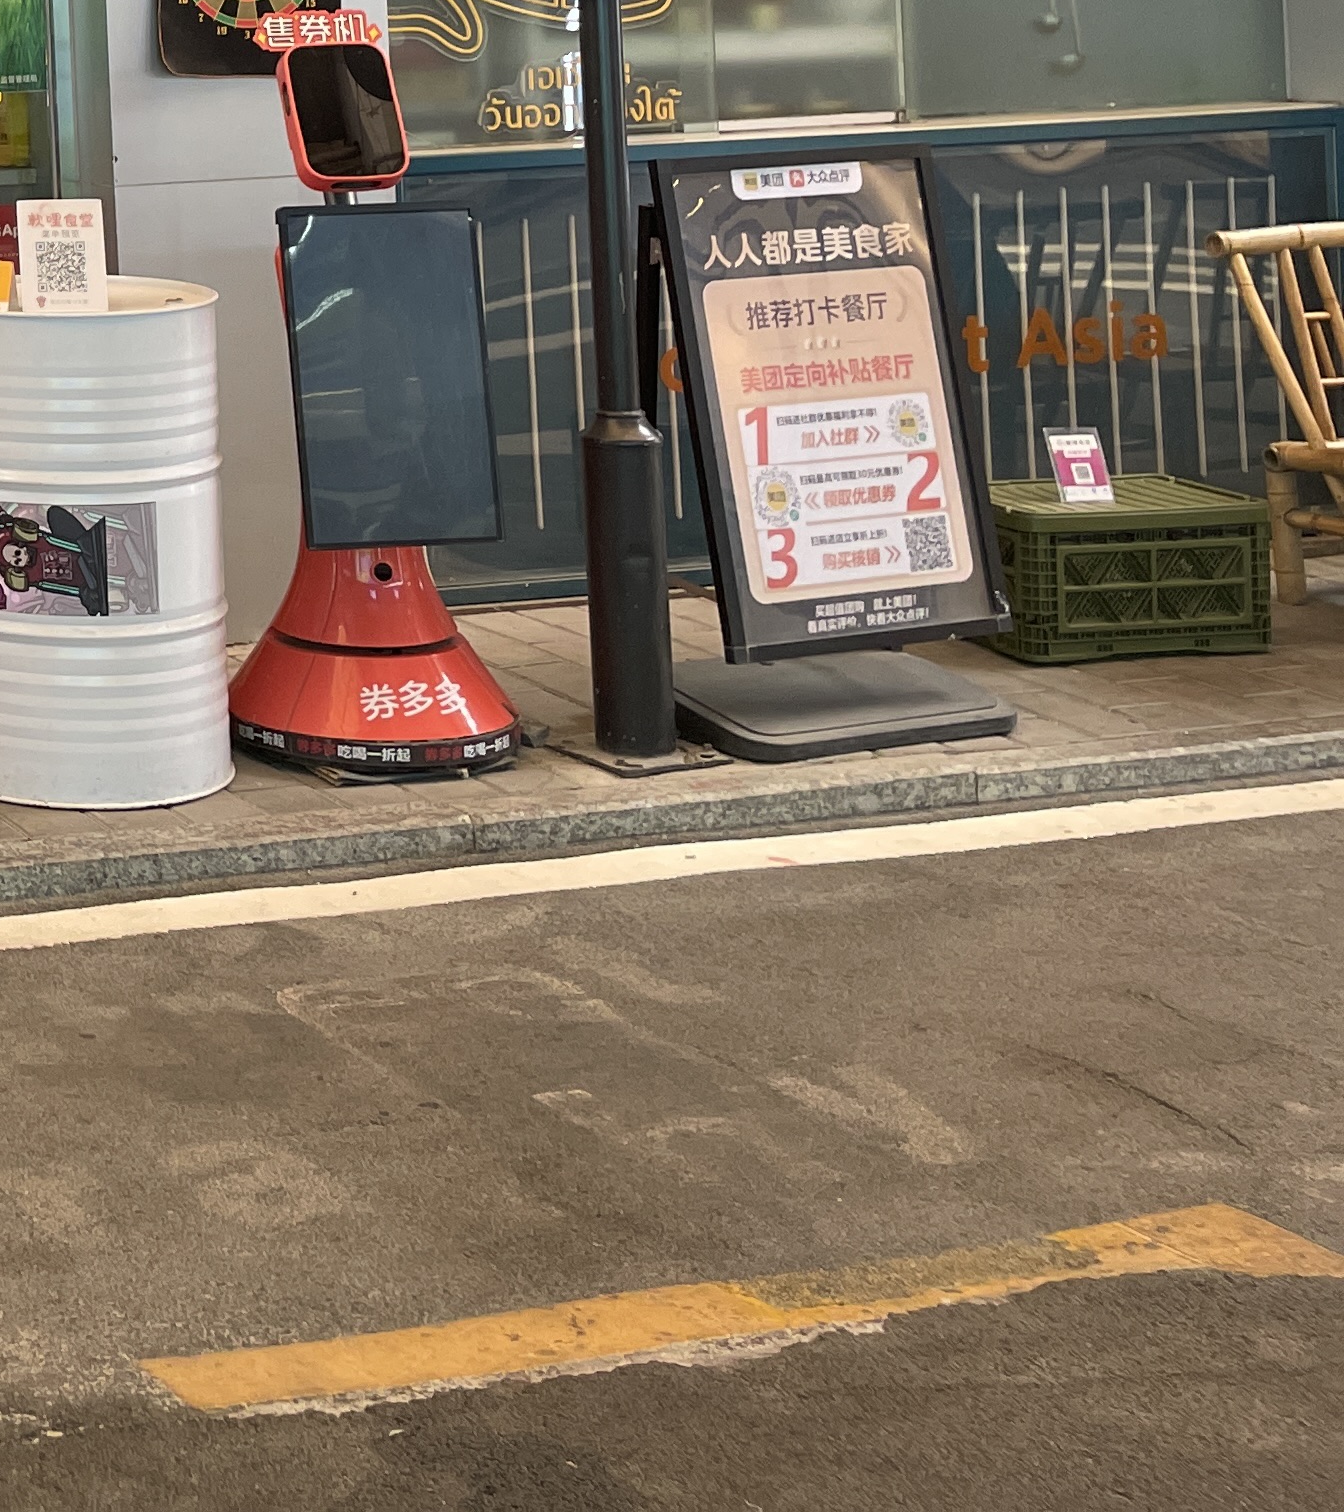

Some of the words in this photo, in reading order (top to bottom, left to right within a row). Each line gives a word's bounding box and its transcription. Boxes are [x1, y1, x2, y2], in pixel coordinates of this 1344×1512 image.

[262, 12, 371, 48] 售券机
[760, 172, 785, 188] 美团
[806, 168, 851, 185] 大众点评
[703, 222, 915, 270] 人人都是美食家
[744, 291, 889, 331] 推荐打卡餐厅
[1017, 300, 1170, 370] Asia
[739, 353, 914, 394] 美团定向补贴餐厅
[744, 405, 769, 466] 1
[800, 426, 860, 450] 加入社群
[907, 451, 942, 511] 2
[766, 527, 799, 590] 3
[359, 678, 467, 721] 券多多
[337, 743, 412, 763] 吃喝一折起
[463, 733, 511, 759] 吃喝一折起
